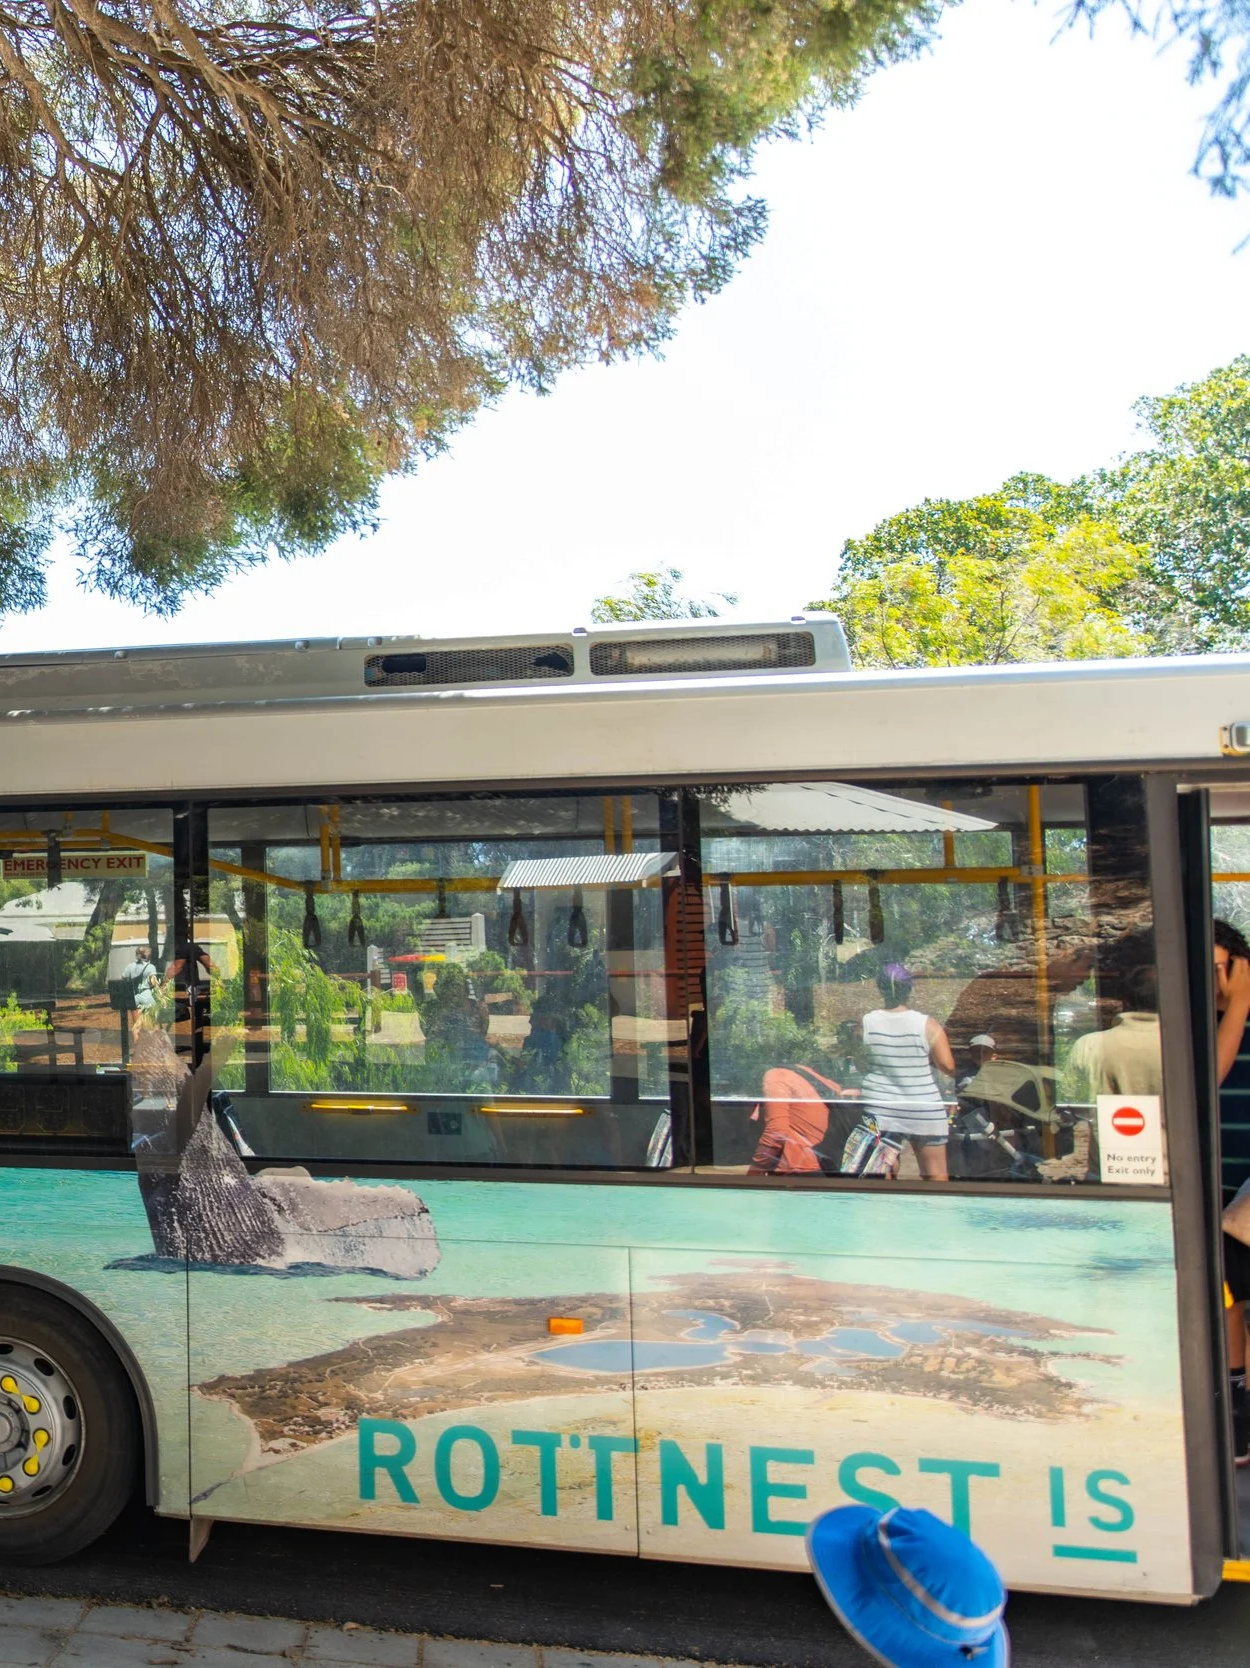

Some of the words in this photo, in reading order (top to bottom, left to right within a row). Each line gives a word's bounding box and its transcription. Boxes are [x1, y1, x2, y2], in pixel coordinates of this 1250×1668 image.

[3, 857, 102, 872] EMERENCY
[106, 856, 144, 869] EXIT
[1106, 1154, 1123, 1162] No
[1127, 1154, 1157, 1164] entry
[1108, 1166, 1130, 1174] Exit
[1133, 1166, 1156, 1176] only
[358, 1418, 1000, 1541] ROTTNEST
[1049, 1465, 1136, 1533] IS
